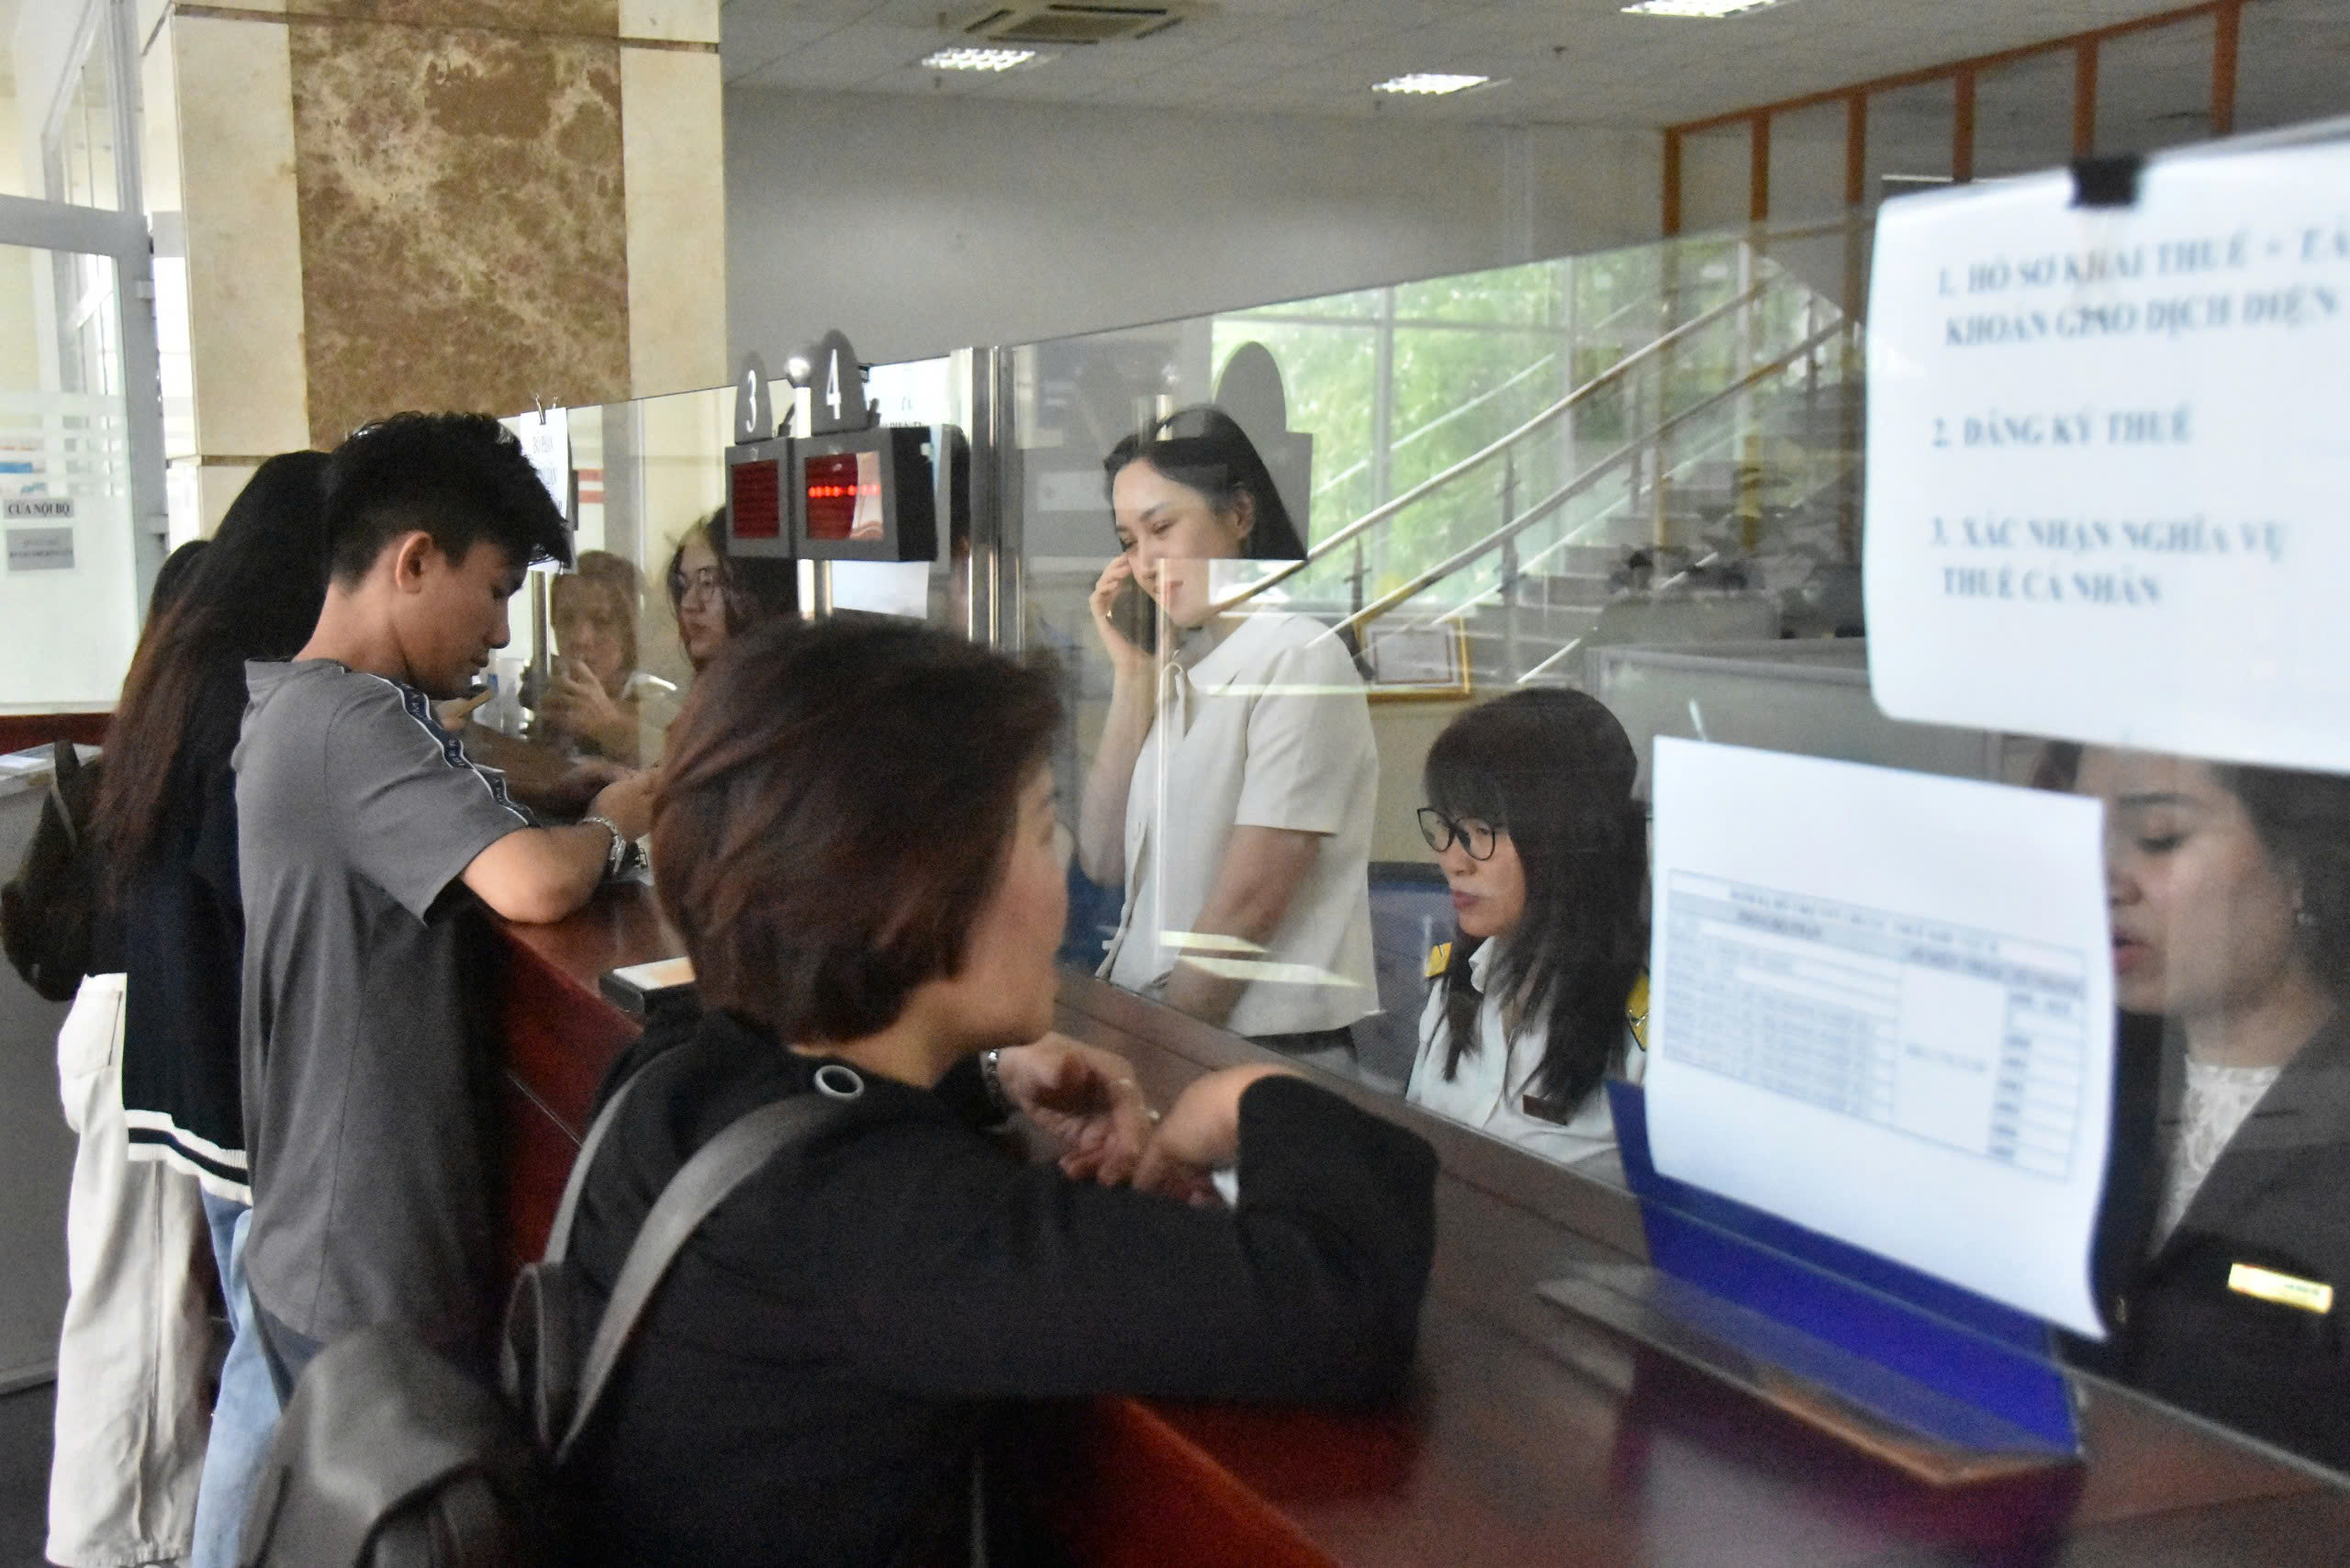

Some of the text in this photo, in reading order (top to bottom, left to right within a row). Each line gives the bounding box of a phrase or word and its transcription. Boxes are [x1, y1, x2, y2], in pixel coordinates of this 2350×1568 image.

[745, 369, 757, 433] 3
[826, 348, 841, 420] 4
[2104, 399, 2195, 447] THUẾ
[1940, 560, 2016, 600] THUẾ
